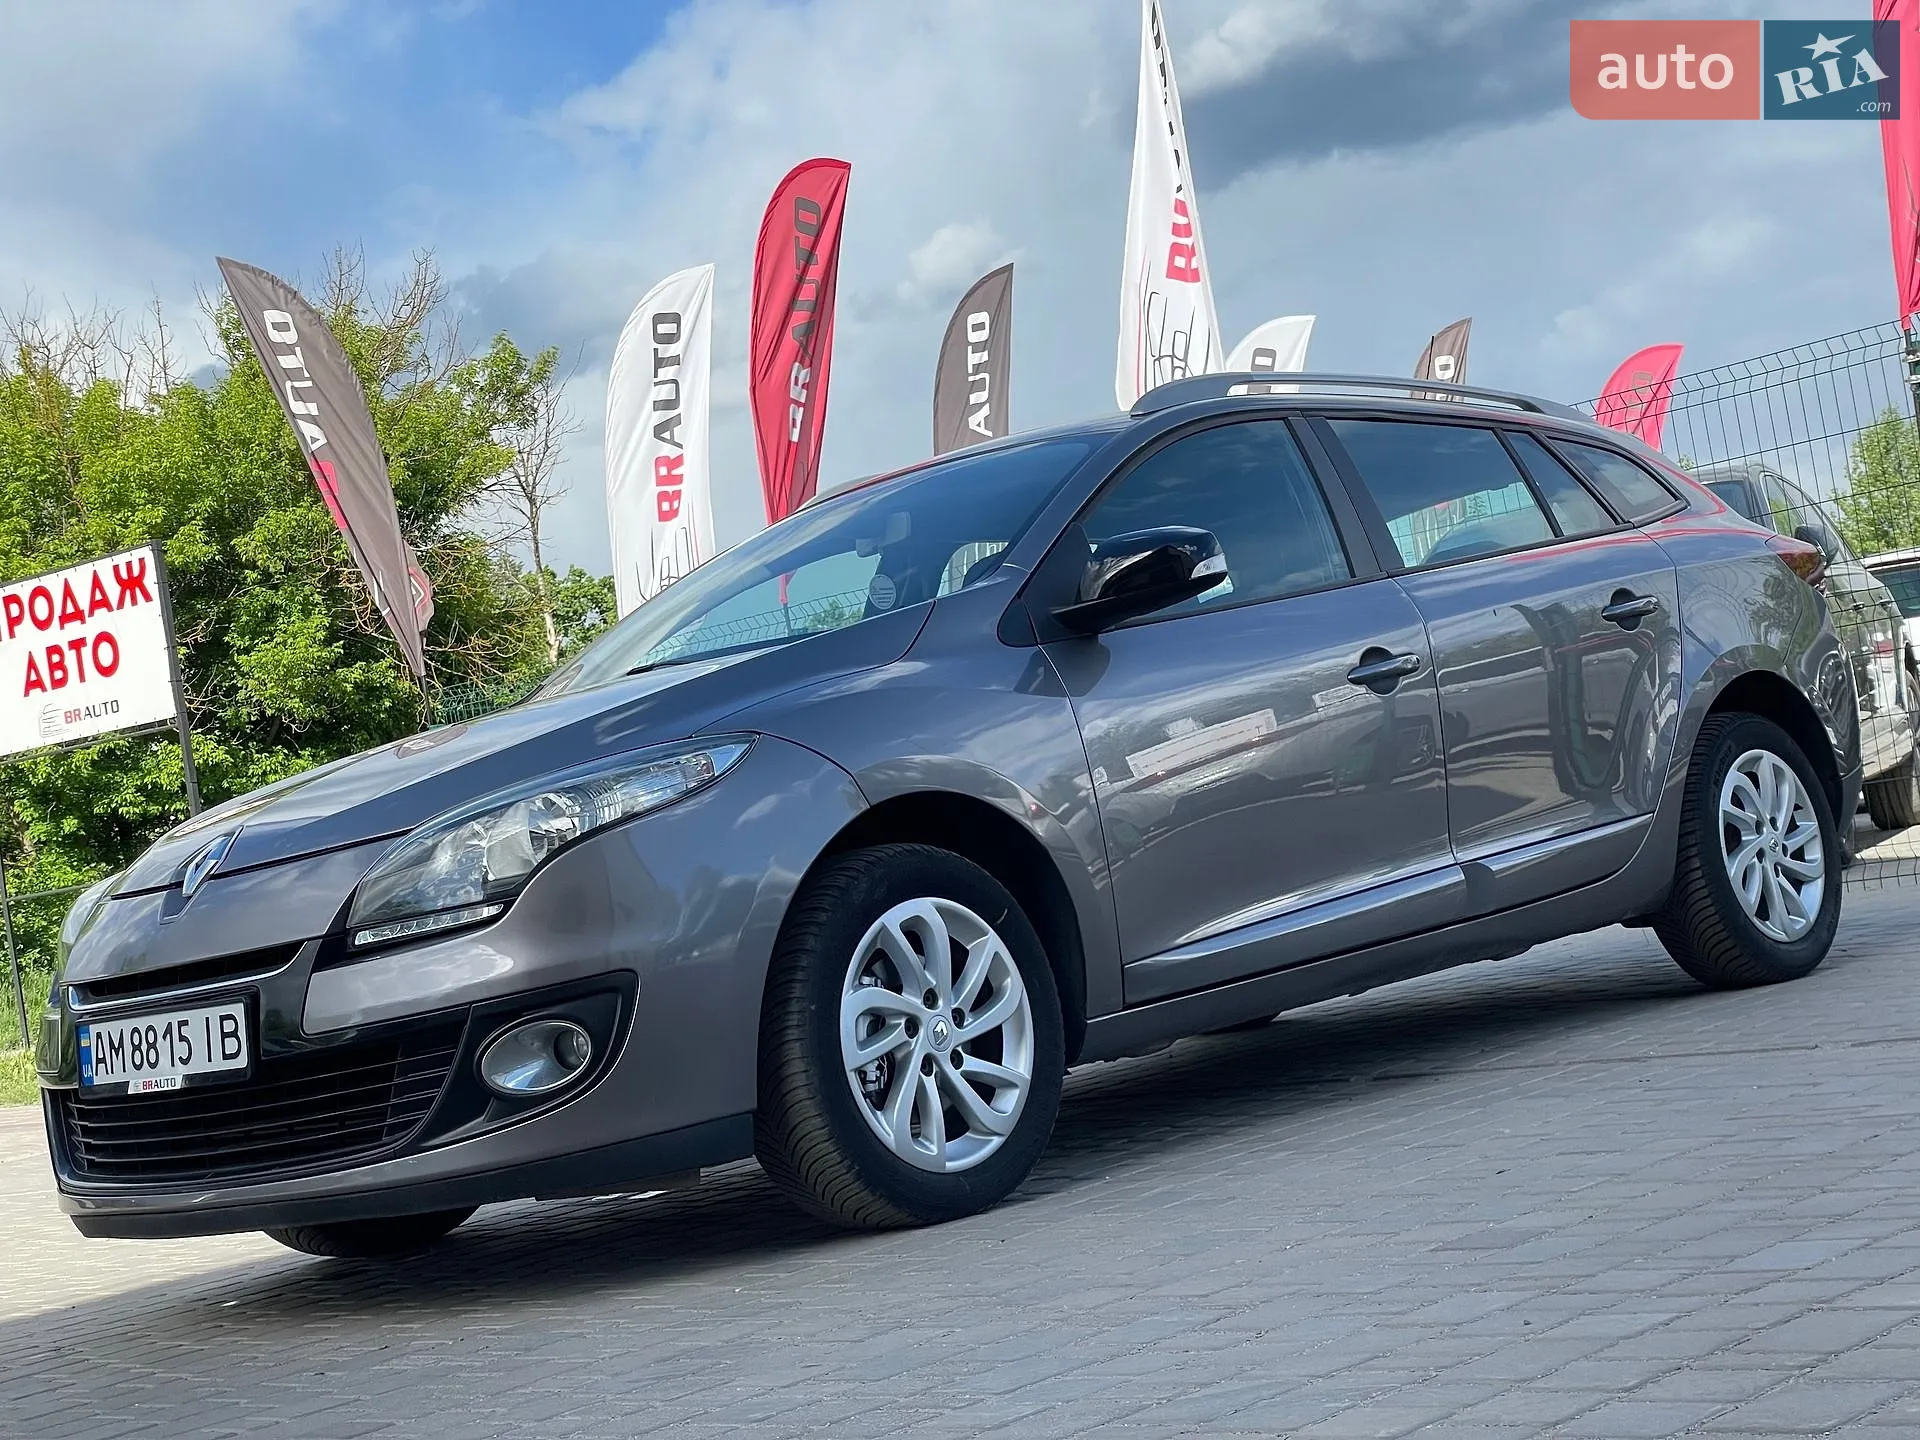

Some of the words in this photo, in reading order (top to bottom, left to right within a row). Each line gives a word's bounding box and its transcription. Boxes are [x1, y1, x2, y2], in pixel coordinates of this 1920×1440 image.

[789, 196, 821, 443] BRAUTO
[966, 311, 993, 438] AUTO
[652, 312, 684, 523] BRAUTO
[0, 557, 153, 642] РОДАЖ
[23, 630, 120, 698] АВТО
[64, 699, 120, 725] BRAUTO
[83, 1065, 93, 1078] UA
[142, 1077, 176, 1091] BRAUTO
